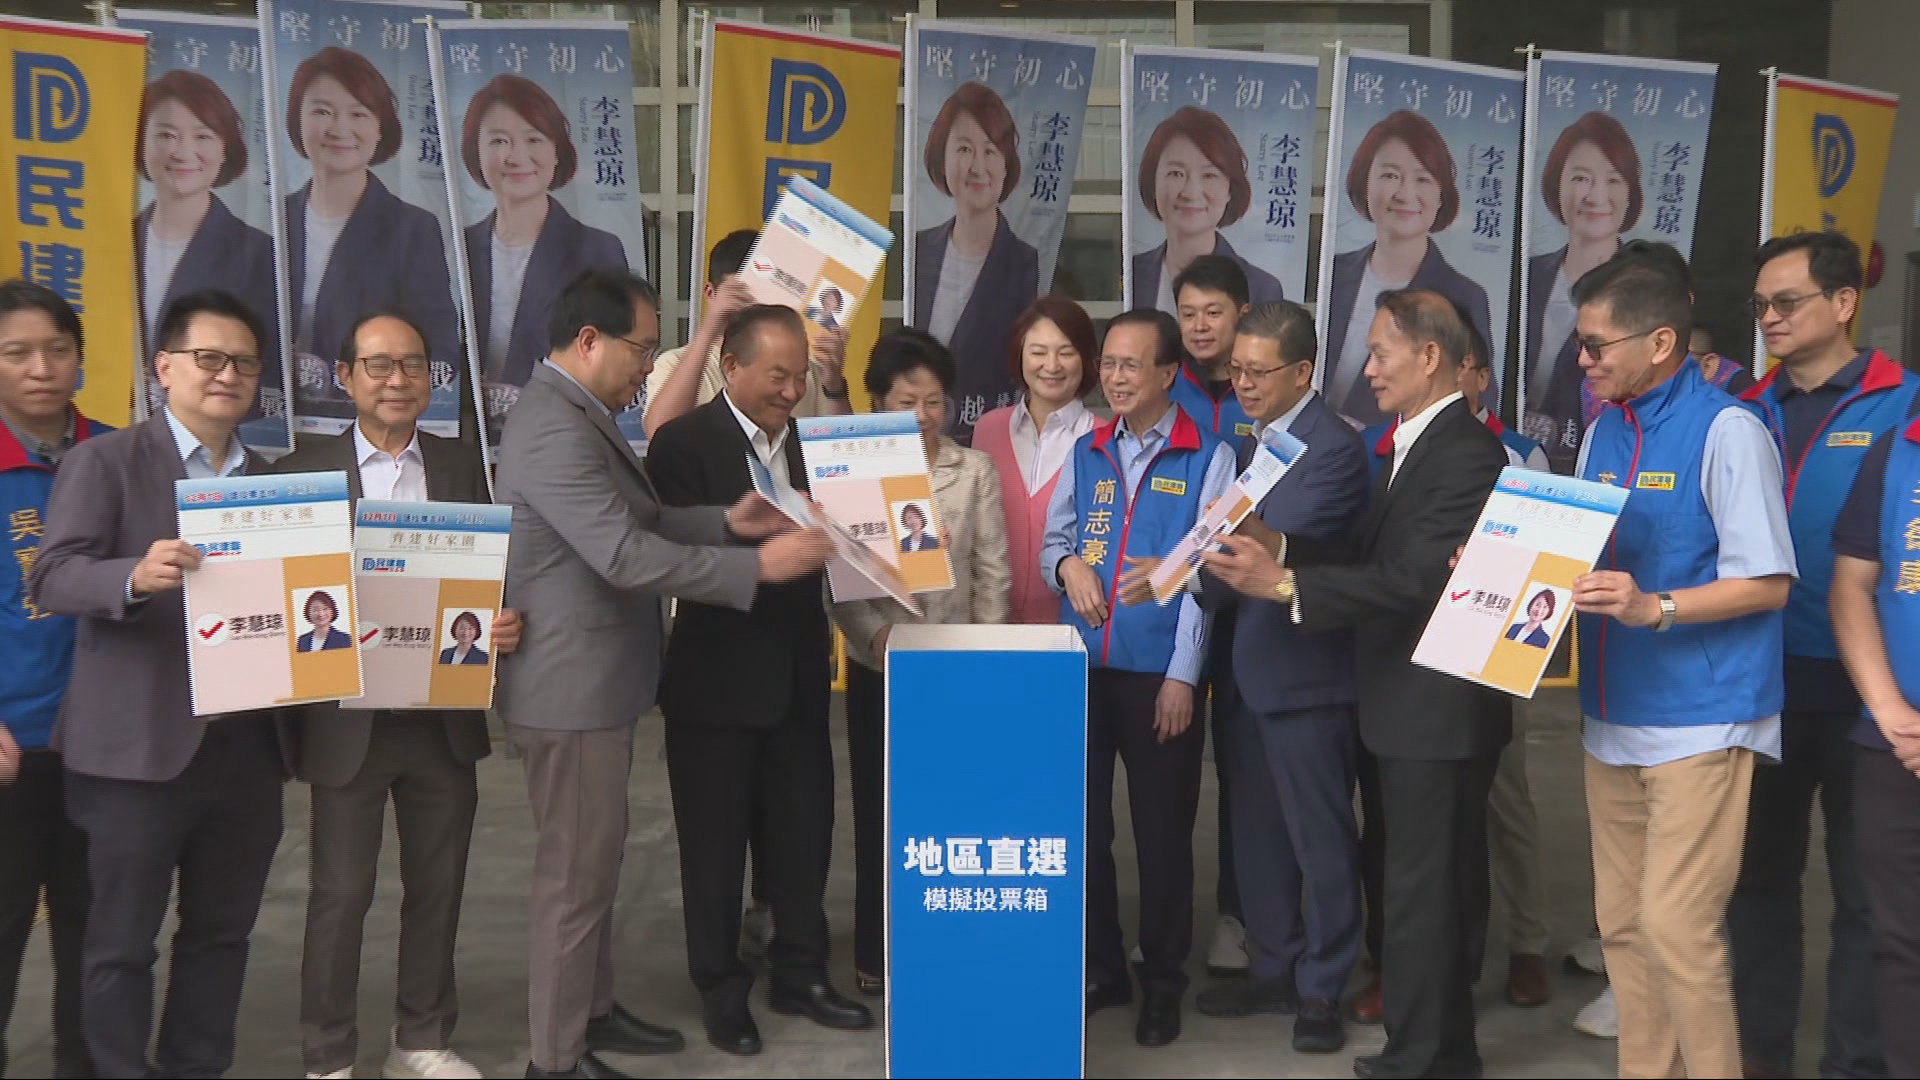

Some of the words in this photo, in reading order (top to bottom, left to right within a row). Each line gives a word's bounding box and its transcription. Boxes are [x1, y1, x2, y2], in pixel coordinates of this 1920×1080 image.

[449, 42, 625, 74] 堅守初心
[925, 44, 1085, 90] 堅守初心
[1140, 70, 1310, 110] 堅守初心
[1353, 72, 1516, 124] 堅守初心
[1545, 74, 1706, 118] 堅守初心
[1081, 478, 1117, 566] 簡志豪
[904, 837, 1067, 876] 地區直選
[923, 887, 1048, 912] 模擬投票箱
